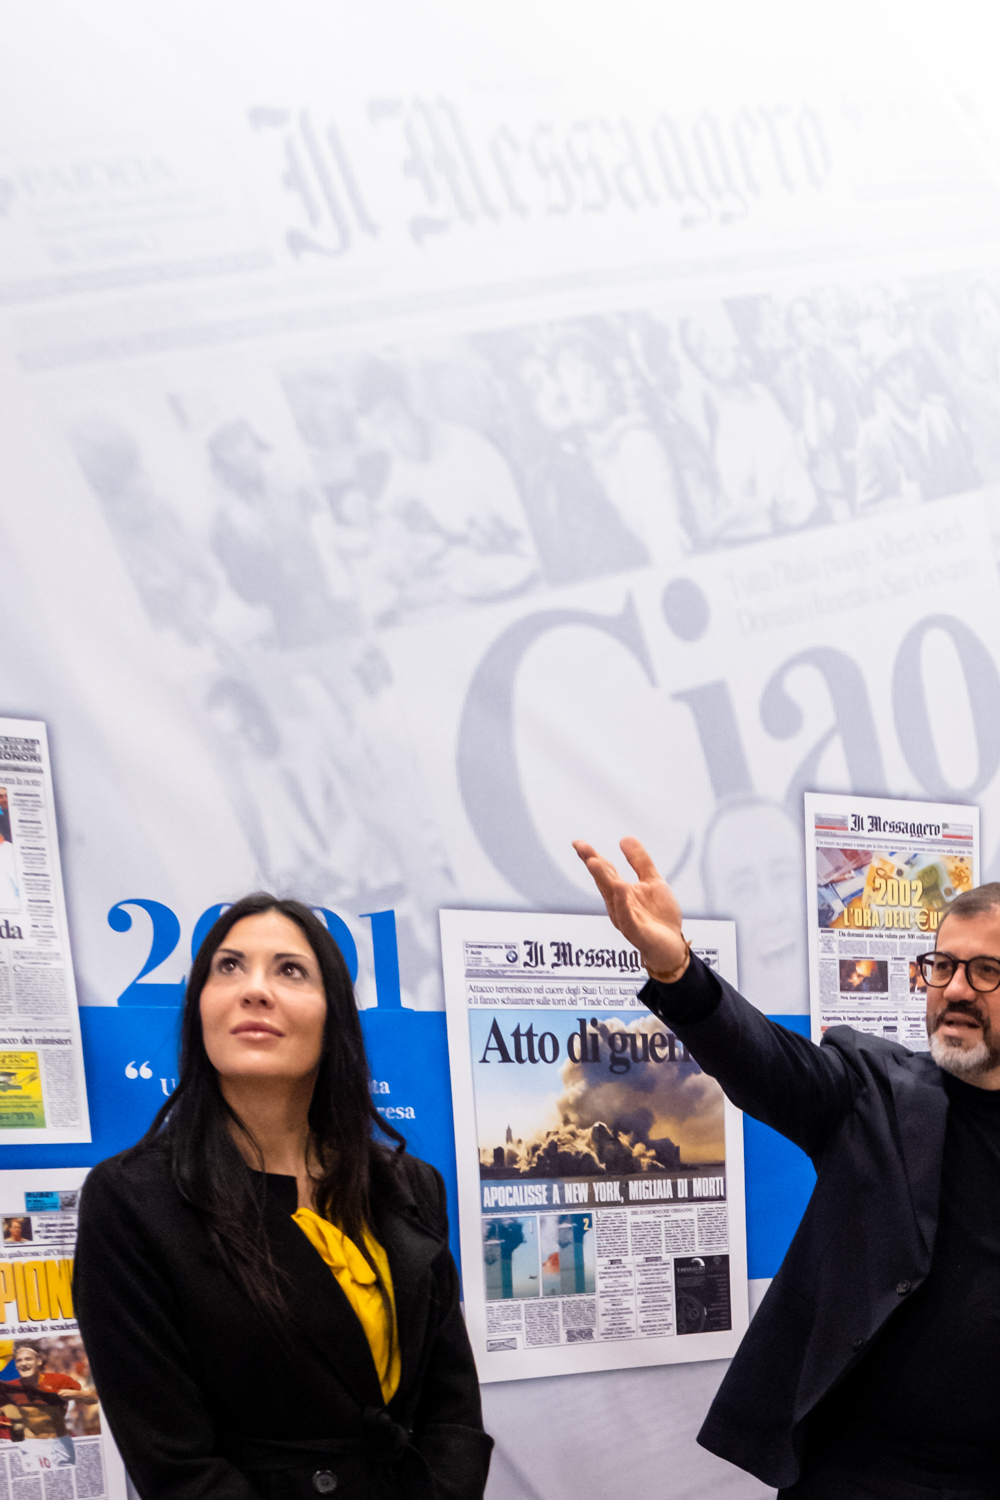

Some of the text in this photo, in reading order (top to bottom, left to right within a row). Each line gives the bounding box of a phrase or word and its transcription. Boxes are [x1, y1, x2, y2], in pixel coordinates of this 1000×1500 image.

[851, 814, 941, 838] Il Messaggero
[874, 878, 923, 907] 2002
[844, 908, 880, 928] L'ORA
[107, 898, 415, 1011] 21
[523, 940, 546, 968] Il
[479, 1017, 560, 1064] Atto
[567, 1017, 600, 1063] di
[483, 1177, 724, 1207] APOCALISSE A NEW YORK, MIGLIAIA DI MORTI
[583, 1218, 590, 1230] 2
[0, 1258, 75, 1325] PION
